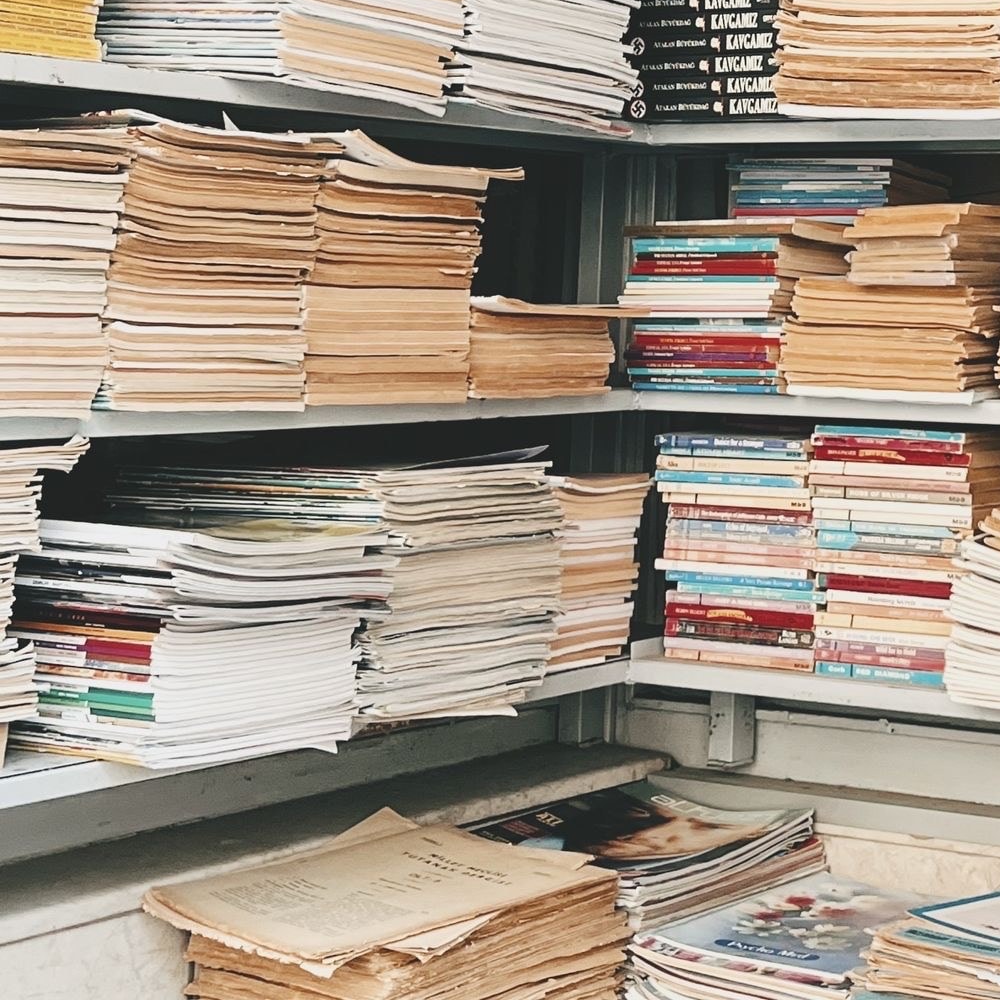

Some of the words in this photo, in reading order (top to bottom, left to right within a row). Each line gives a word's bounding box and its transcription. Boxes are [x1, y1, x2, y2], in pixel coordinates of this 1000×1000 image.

[710, 12, 758, 30] KAVGAMIZ
[726, 32, 773, 50] KAVGAMIZ
[715, 55, 764, 73] KAVGAMIZ
[729, 98, 778, 115] KAVGAMIZ
